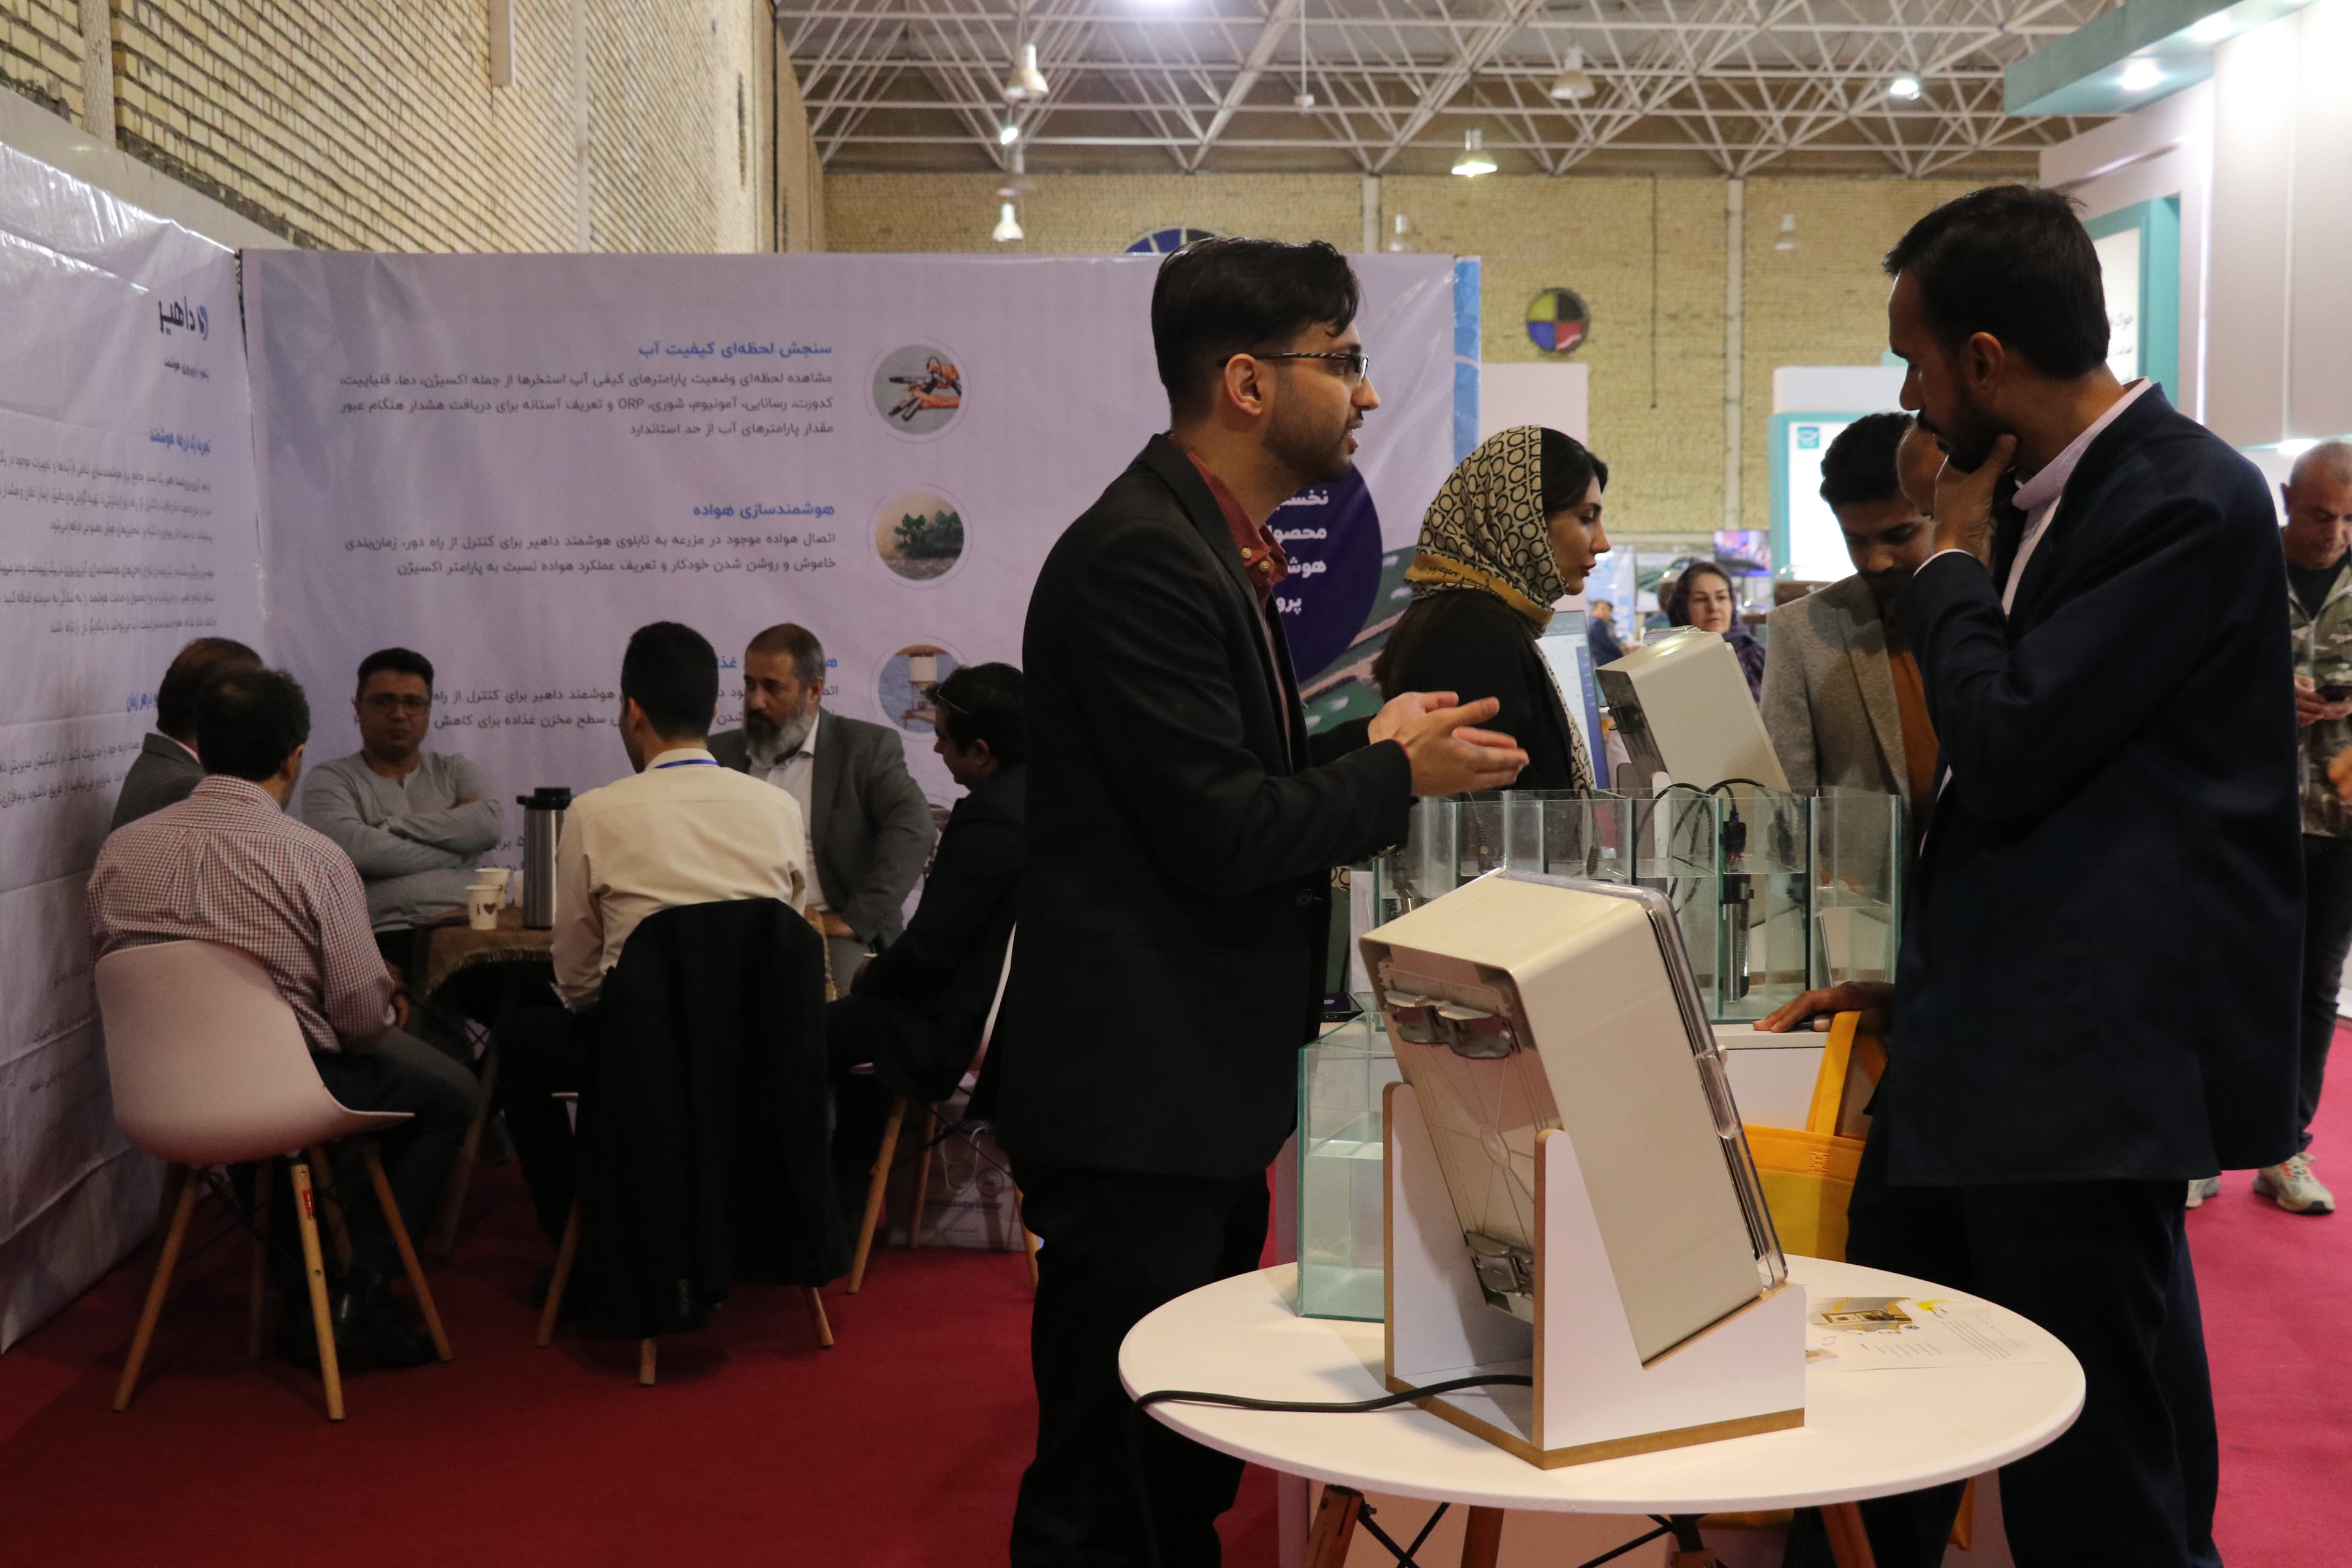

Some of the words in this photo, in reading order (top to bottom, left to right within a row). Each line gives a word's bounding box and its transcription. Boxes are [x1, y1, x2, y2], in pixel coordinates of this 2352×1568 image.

[638, 341, 660, 358] آب
[666, 341, 715, 358] کیفیت
[779, 342, 832, 358] سنجش
[472, 375, 500, 387] جمله
[505, 374, 513, 388] از
[518, 374, 566, 388] استخرها
[570, 372, 588, 387] آب
[593, 372, 624, 387] کیفی
[628, 373, 687, 388] پارامترهای
[691, 374, 736, 386] وضعیت
[788, 372, 832, 383] مشاهده
[341, 402, 364, 413] عبور
[369, 398, 404, 413] هنگام
[409, 399, 445, 413] هشدار
[449, 399, 491, 413] دریافت
[496, 399, 518, 413] برای
[522, 398, 561, 410] آستانه
[566, 399, 603, 412] تعریف
[607, 402, 613, 412] و
[618, 398, 644, 409] ORP
[630, 423, 680, 437] استاندارد
[706, 423, 714, 437] از
[718, 421, 737, 436] آب
[741, 423, 799, 437] پارامترهای
[804, 423, 834, 436] مقدار
[693, 503, 734, 519] هواده
[740, 502, 835, 519] هوشمندسازی
[429, 537, 444, 551] راه
[448, 537, 458, 551] از
[462, 535, 494, 550] کنترل
[500, 536, 522, 550] برای
[527, 536, 560, 549] داهیر
[565, 535, 611, 548] هوشمند
[616, 535, 650, 549] تابلوی
[655, 537, 667, 547] به
[671, 535, 704, 548] مزرعه
[709, 537, 722, 548] در
[727, 537, 761, 548] موجود
[766, 534, 798, 546] هواده
[803, 533, 835, 547] اتصال
[397, 561, 442, 576] اکسیژن
[447, 562, 483, 576] پارامتر
[486, 564, 499, 574] به
[503, 561, 537, 574] نسبت
[541, 560, 574, 574] هواده
[578, 559, 615, 574] عملکرد
[620, 560, 656, 573] تعریف
[661, 563, 667, 573] و
[671, 559, 709, 573] خودکار
[713, 559, 742, 573] شدن
[746, 558, 779, 572] روشن
[783, 562, 790, 571] و
[794, 557, 836, 571] خاموش
[1287, 556, 1327, 578] هوش
[453, 690, 461, 704] از
[467, 688, 500, 704] کنترل
[505, 689, 526, 704] برای
[532, 689, 564, 703] داهیر
[569, 688, 615, 703] هوشمند
[434, 714, 473, 729] کاهش
[478, 715, 500, 728] برای
[505, 715, 535, 725] غذاده
[541, 714, 573, 728] مخزن
[577, 714, 606, 728] سطح
